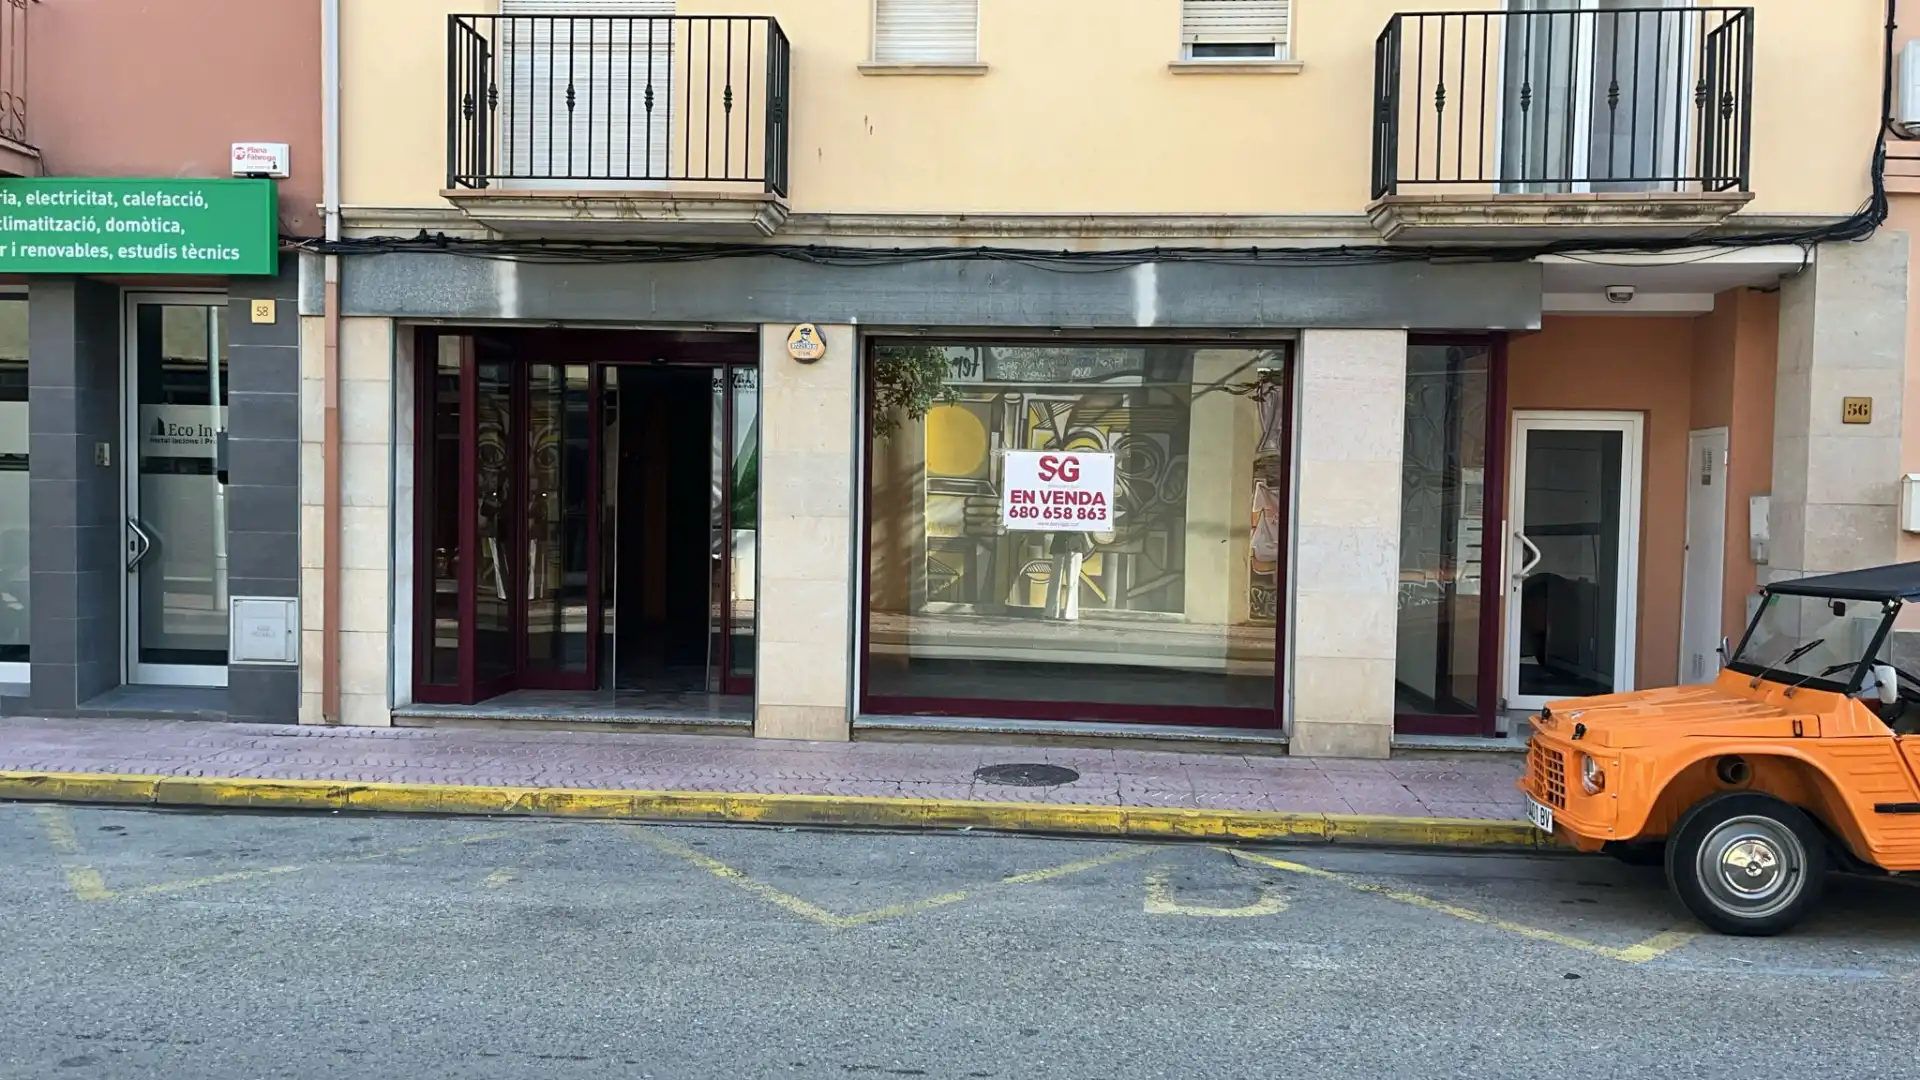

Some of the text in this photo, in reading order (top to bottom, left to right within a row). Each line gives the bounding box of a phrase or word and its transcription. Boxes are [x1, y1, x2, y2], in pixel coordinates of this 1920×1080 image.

[26, 189, 118, 208] electricitat,
[123, 189, 208, 209] calefacció,
[106, 216, 185, 236] domòtica,
[11, 241, 16, 257] i
[21, 242, 114, 261] renovables,
[118, 243, 177, 259] estudis
[181, 243, 240, 260] tècnics
[256, 305, 269, 317] 58
[1847, 403, 1868, 417] 56
[168, 423, 194, 437] Eco
[1038, 455, 1080, 482] SG
[1010, 490, 1106, 506] EN VENDA
[1009, 505, 1107, 521] 680 658 863
